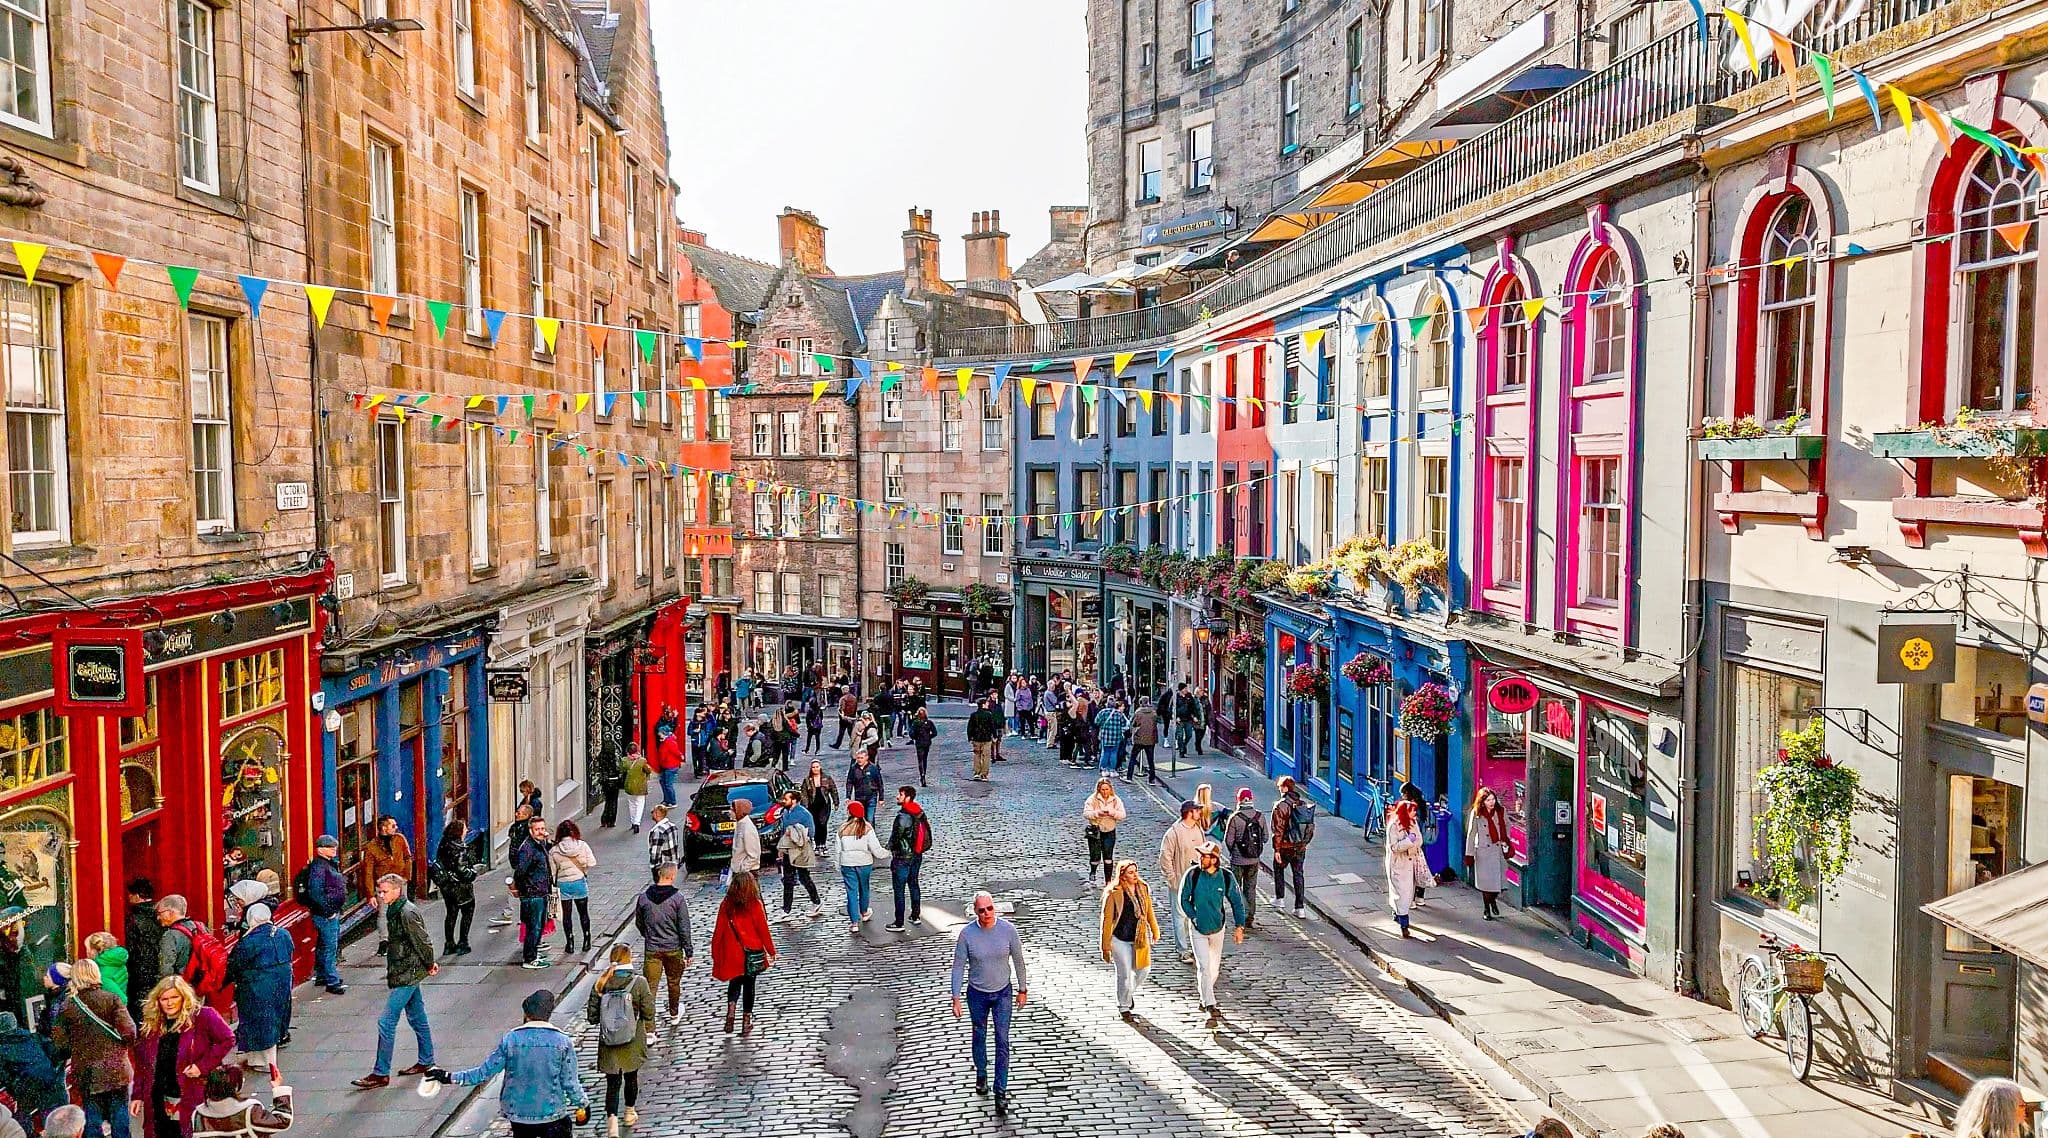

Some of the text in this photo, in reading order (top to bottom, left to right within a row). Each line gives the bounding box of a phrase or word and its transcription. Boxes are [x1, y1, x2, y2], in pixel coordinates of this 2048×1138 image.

[279, 485, 306, 496] VICTORIA
[283, 496, 303, 507] STREET
[339, 575, 352, 584] WEST
[1043, 567, 1067, 579] Walker
[1070, 569, 1092, 580] Slater
[526, 606, 555, 630] SAHARA
[349, 673, 371, 690] SPIRIT
